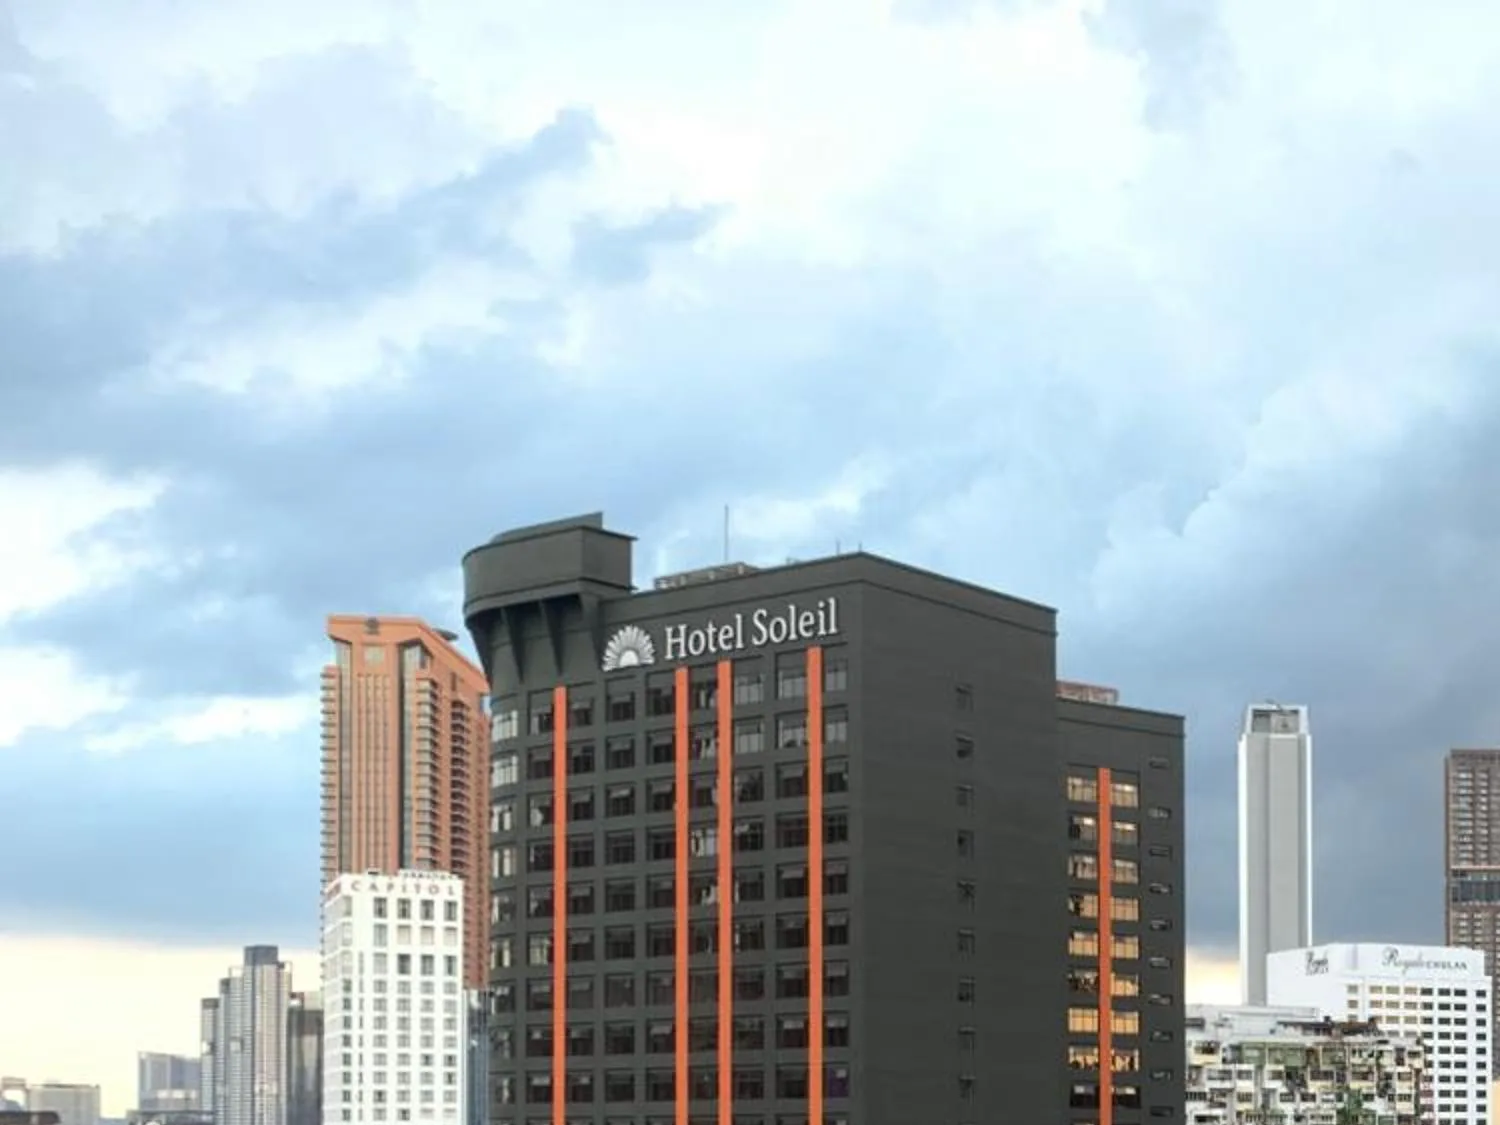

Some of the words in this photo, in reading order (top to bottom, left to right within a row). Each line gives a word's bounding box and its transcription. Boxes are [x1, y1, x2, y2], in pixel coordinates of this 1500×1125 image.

[664, 614, 744, 660] Hotel
[752, 598, 838, 646] Soleil
[351, 881, 454, 896] CAPITOL
[1426, 960, 1467, 970] CHULAN
